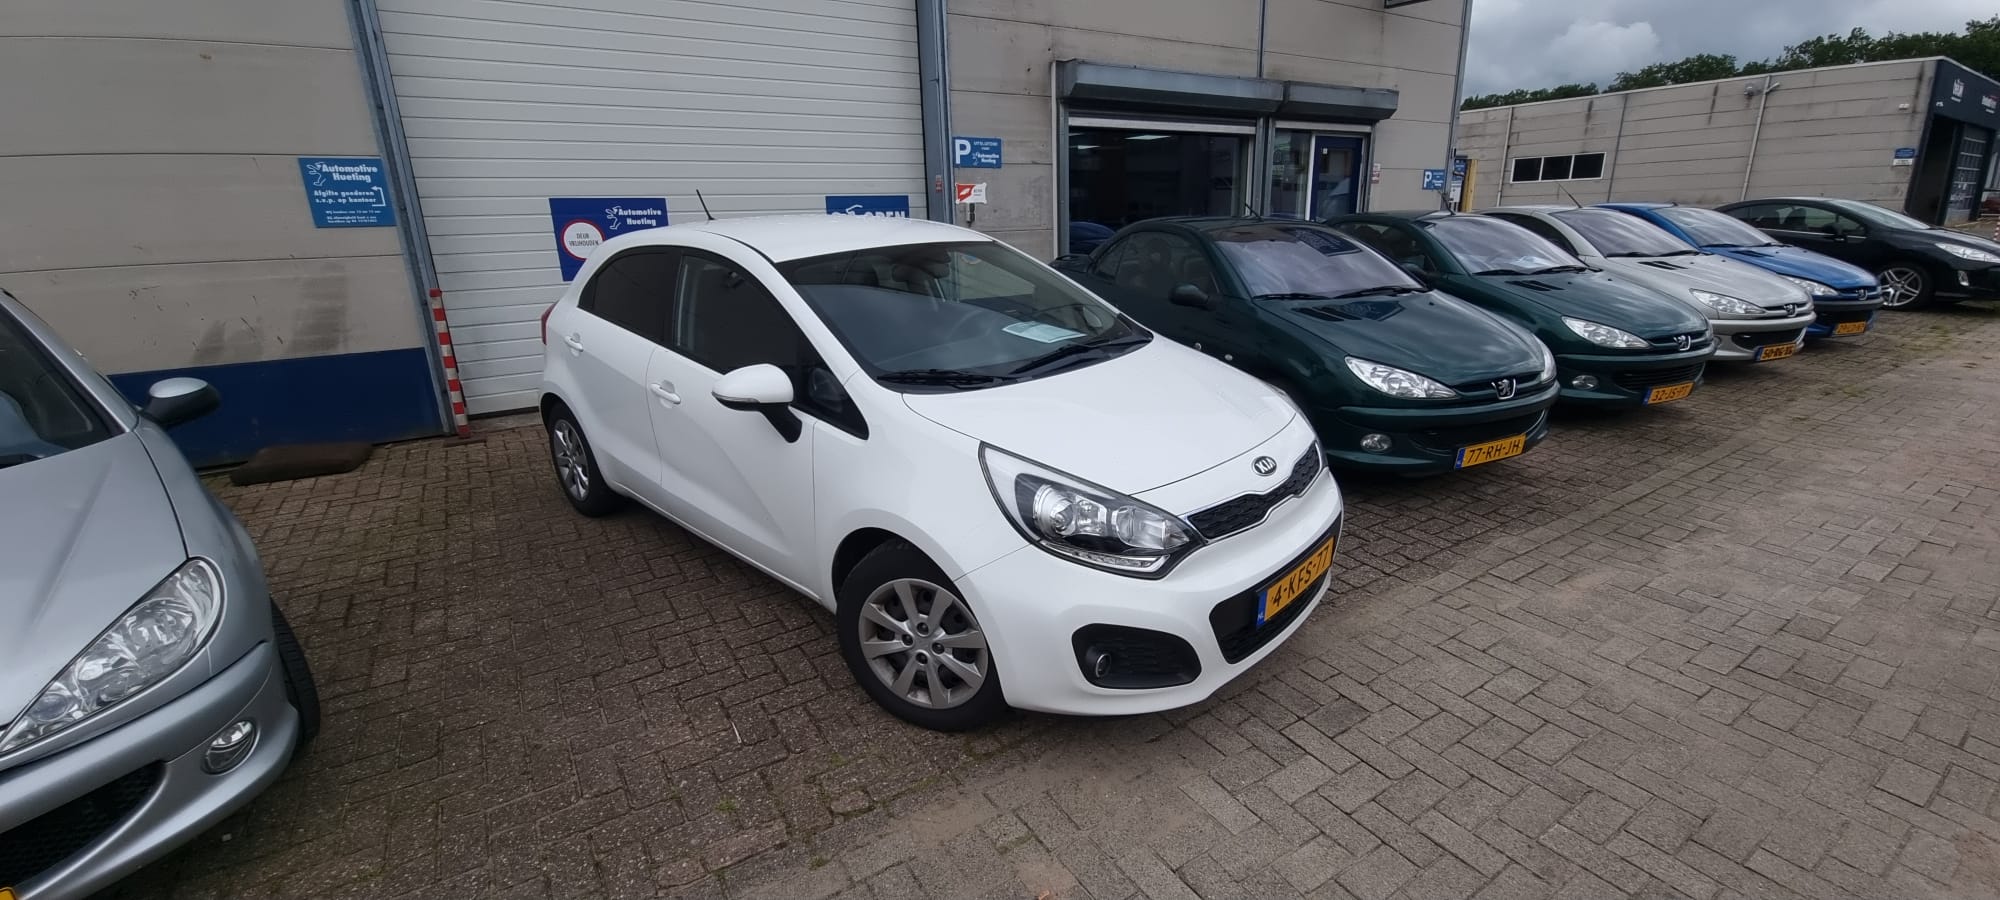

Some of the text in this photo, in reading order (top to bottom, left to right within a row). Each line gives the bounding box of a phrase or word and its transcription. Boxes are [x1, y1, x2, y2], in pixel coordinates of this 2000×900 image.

[955, 139, 971, 164] P
[322, 164, 378, 172] Automotive
[332, 172, 371, 183] Hueting
[619, 207, 662, 216] Automotive
[626, 217, 657, 226] Hueting
[1467, 438, 1521, 464] 77-RH-JH
[1255, 457, 1276, 474] KIA
[1272, 544, 1330, 607] 4-KFS-77
